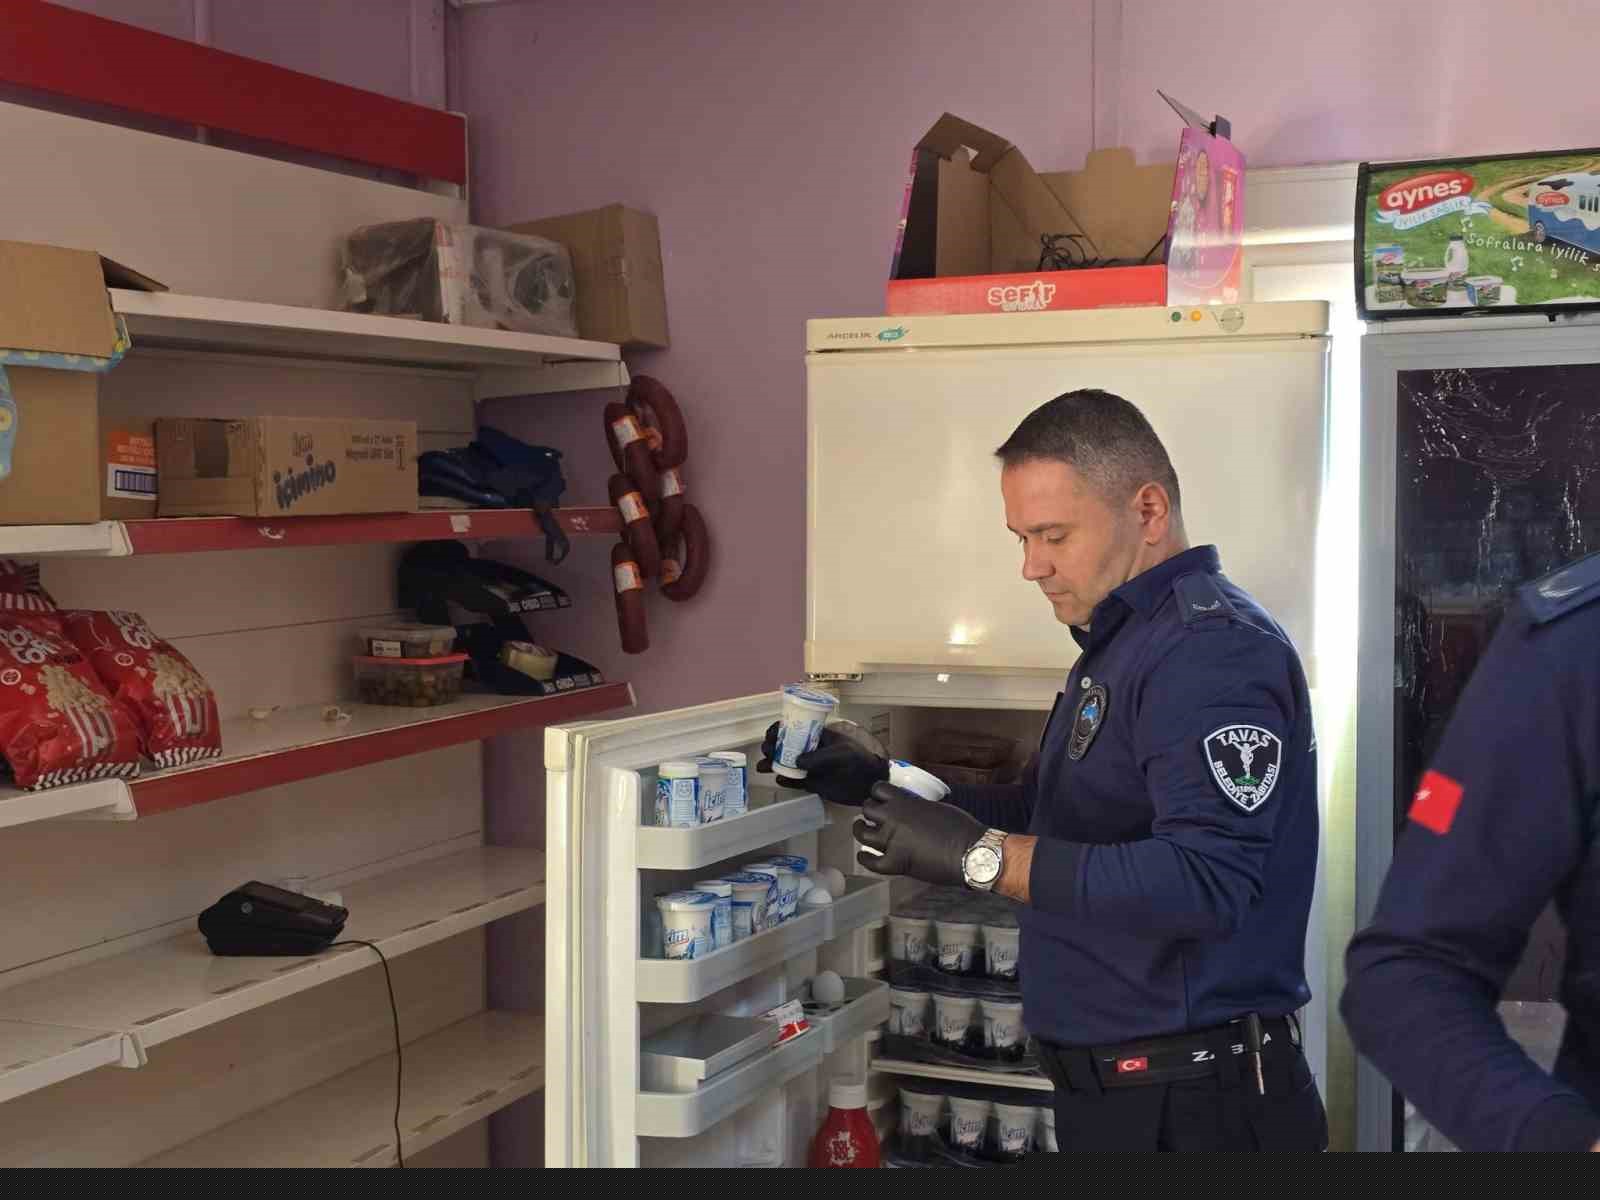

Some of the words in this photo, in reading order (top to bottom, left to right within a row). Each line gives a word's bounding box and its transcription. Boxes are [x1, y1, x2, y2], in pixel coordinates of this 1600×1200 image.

[1386, 179, 1462, 209] aynes
[1467, 233, 1543, 252] Sofralara
[1551, 243, 1590, 265] iyilik
[1216, 729, 1271, 747] TAVAS
